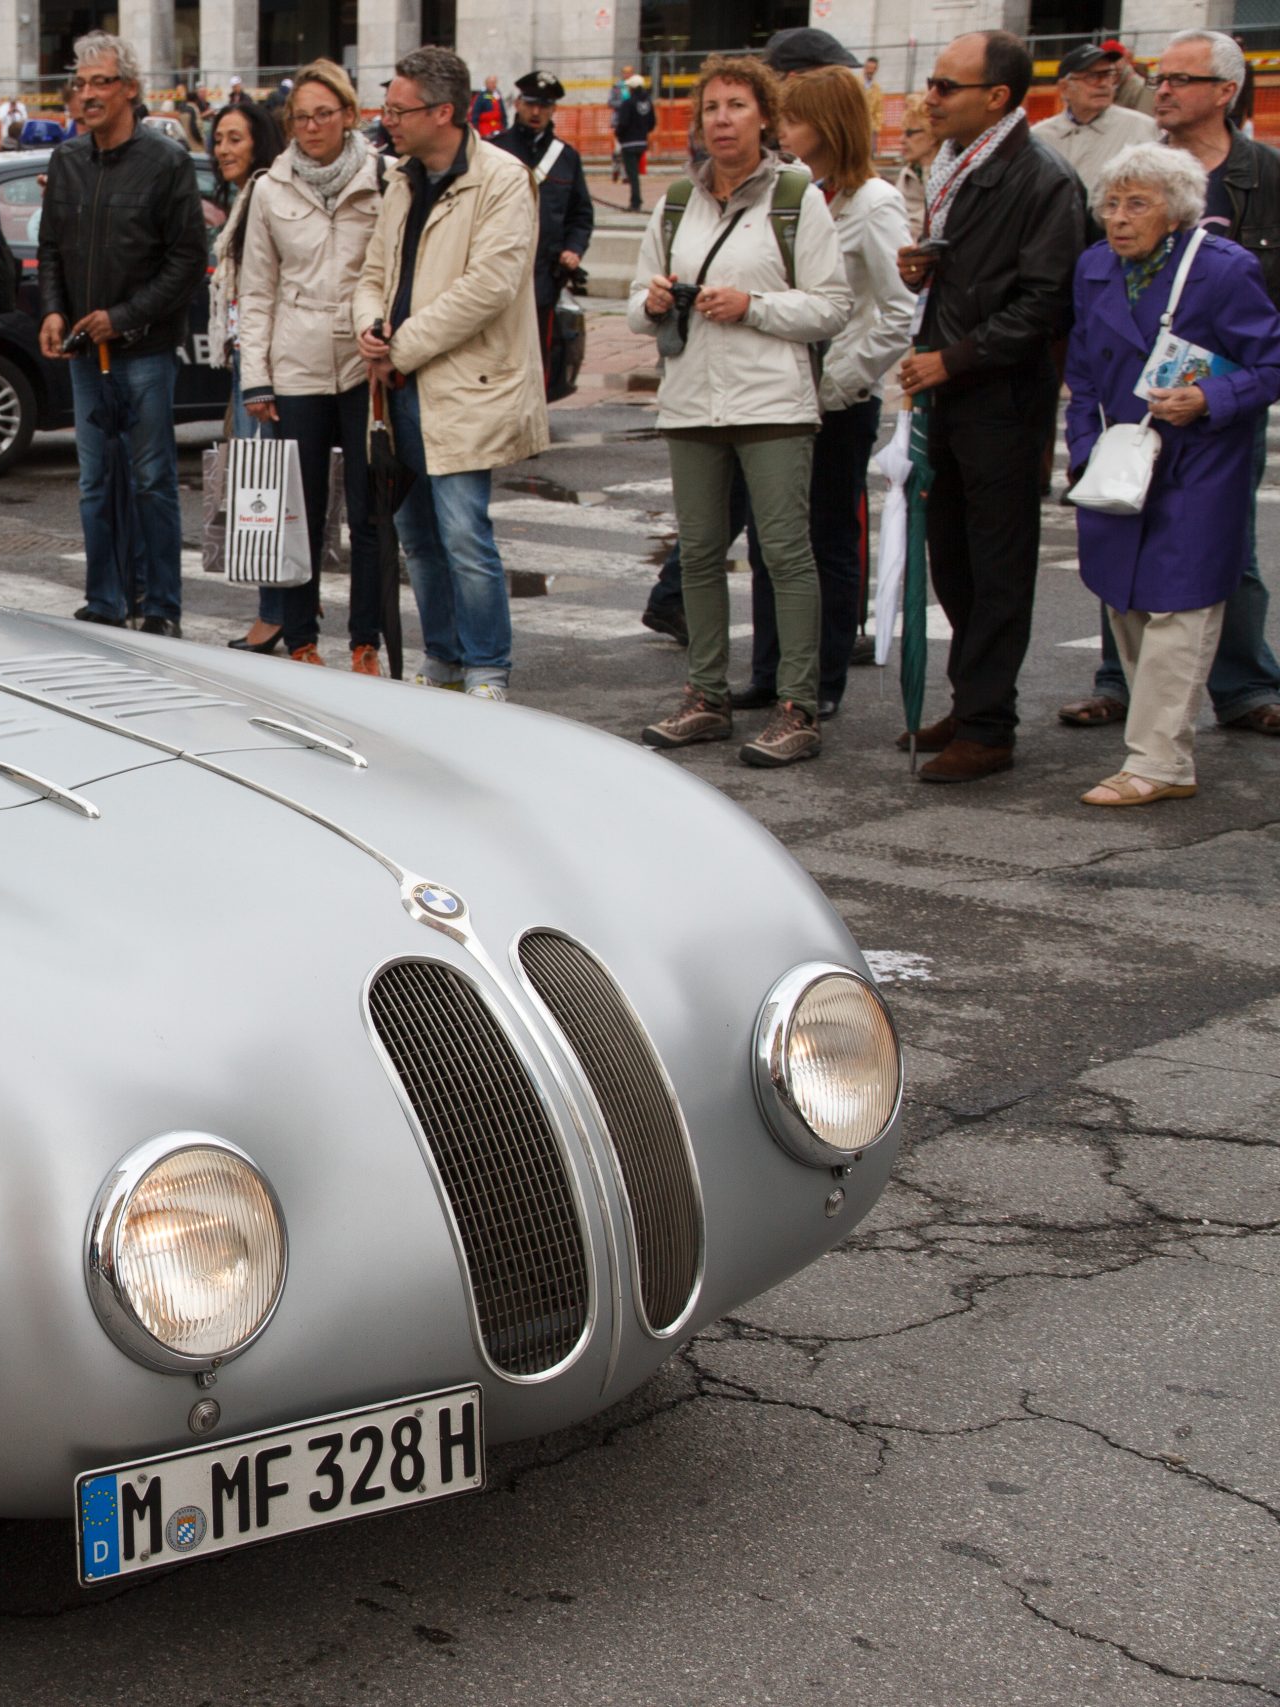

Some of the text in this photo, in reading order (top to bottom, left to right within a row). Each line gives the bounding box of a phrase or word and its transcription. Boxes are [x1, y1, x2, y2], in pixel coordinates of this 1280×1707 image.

[122, 1476, 163, 1561] M
[211, 1444, 293, 1539] MF
[308, 1415, 425, 1513] 328
[438, 1402, 476, 1484] H
[93, 1540, 109, 1564] D
